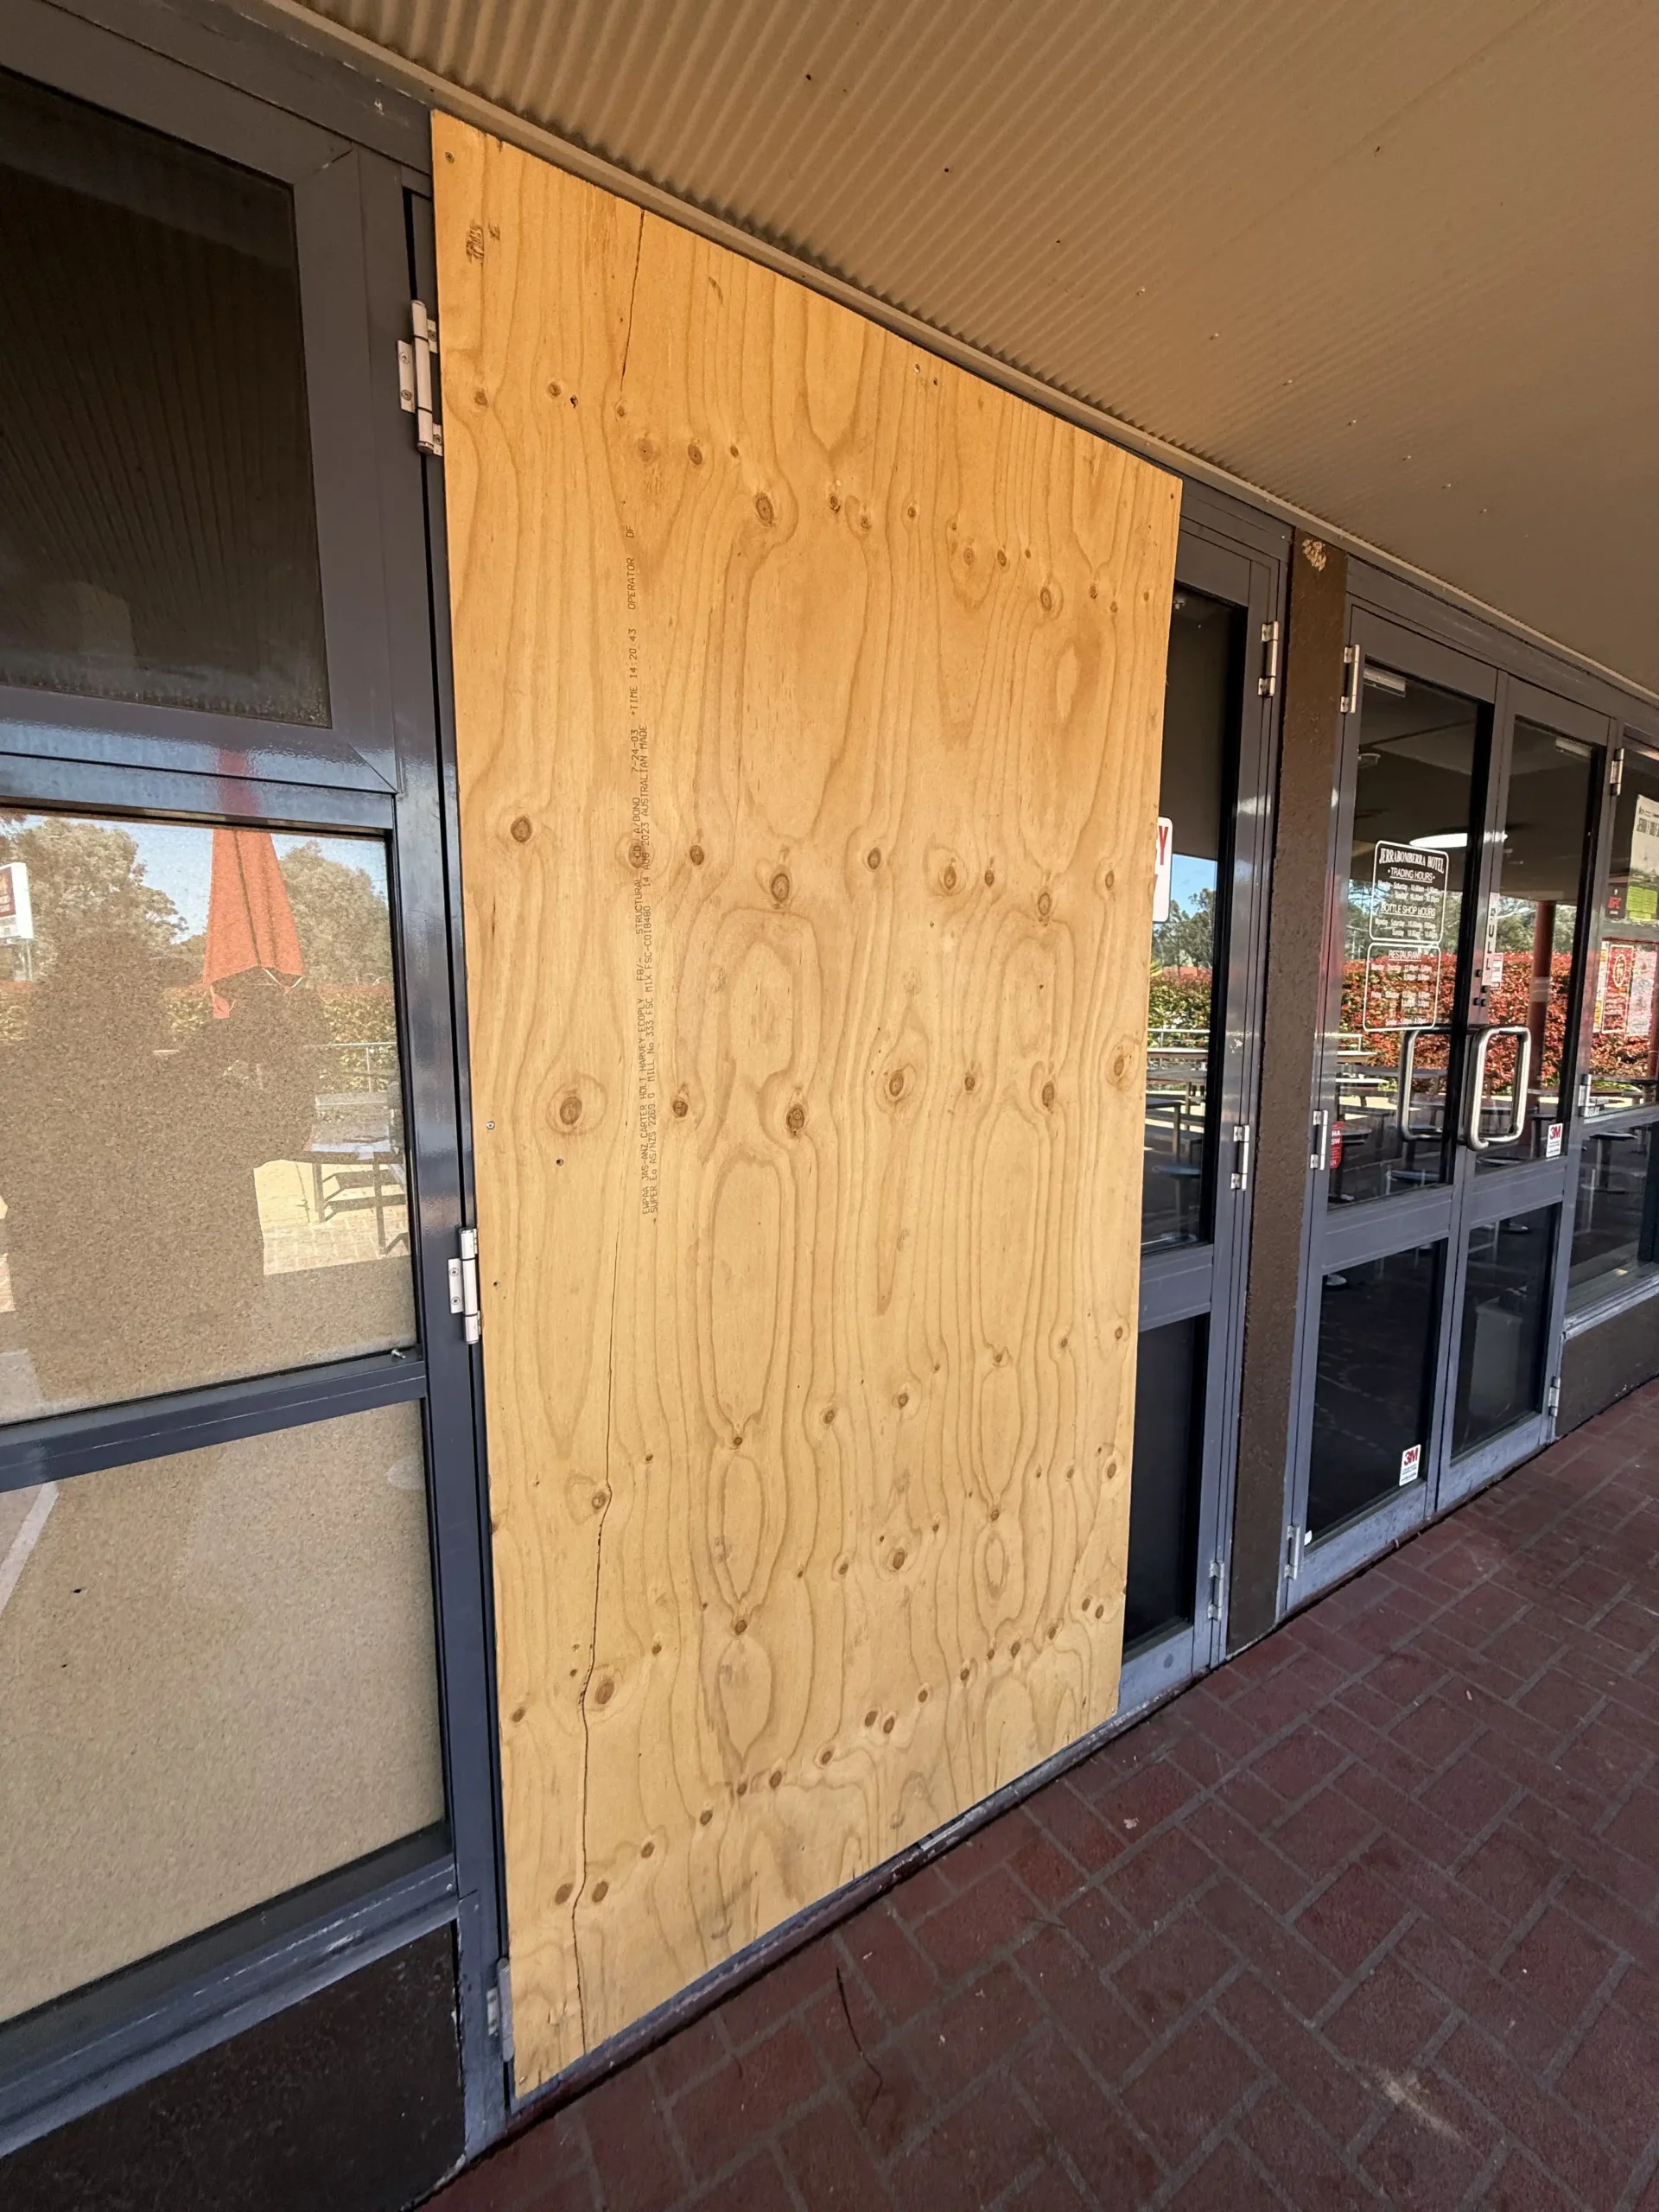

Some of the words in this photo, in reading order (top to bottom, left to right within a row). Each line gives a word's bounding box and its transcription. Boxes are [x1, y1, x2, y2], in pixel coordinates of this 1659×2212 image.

[626, 525, 635, 538] DF
[627, 557, 637, 610] OPERATOR
[639, 725, 648, 749] MADE
[632, 729, 640, 772] 7-24-03
[640, 755, 650, 816] AUSTRALIAN
[641, 822, 651, 846] 2023
[1156, 825, 1169, 865] Y
[634, 845, 642, 858] CD
[1378, 848, 1426, 867] JERRABOMBERRA
[1427, 855, 1445, 874] HOTEL
[643, 876, 652, 887] 14
[1390, 867, 1414, 879] TRADING
[1414, 871, 1433, 881] HOURS
[635, 876, 645, 934] STRUCTURAL
[1381, 901, 1402, 913] BOTTLE
[1402, 905, 1417, 914] SHOP
[1418, 906, 1436, 916] HOURS
[1389, 950, 1421, 959] RESTAURANT
[645, 974, 654, 992] MIX
[638, 998, 646, 1032] ECOPLY
[646, 1020, 655, 1037] 333
[647, 1042, 655, 1054] No
[647, 1059, 656, 1082] MILL
[639, 1077, 648, 1099] HOLT
[640, 1105, 649, 1139] CARTER
[1549, 1126, 1561, 1140] 3M
[649, 1131, 658, 1164] AS/NZS
[641, 1144, 650, 1181] JAS-ANZ
[650, 1185, 658, 1212] SUPER
[1404, 1447, 1419, 1466] 3M
